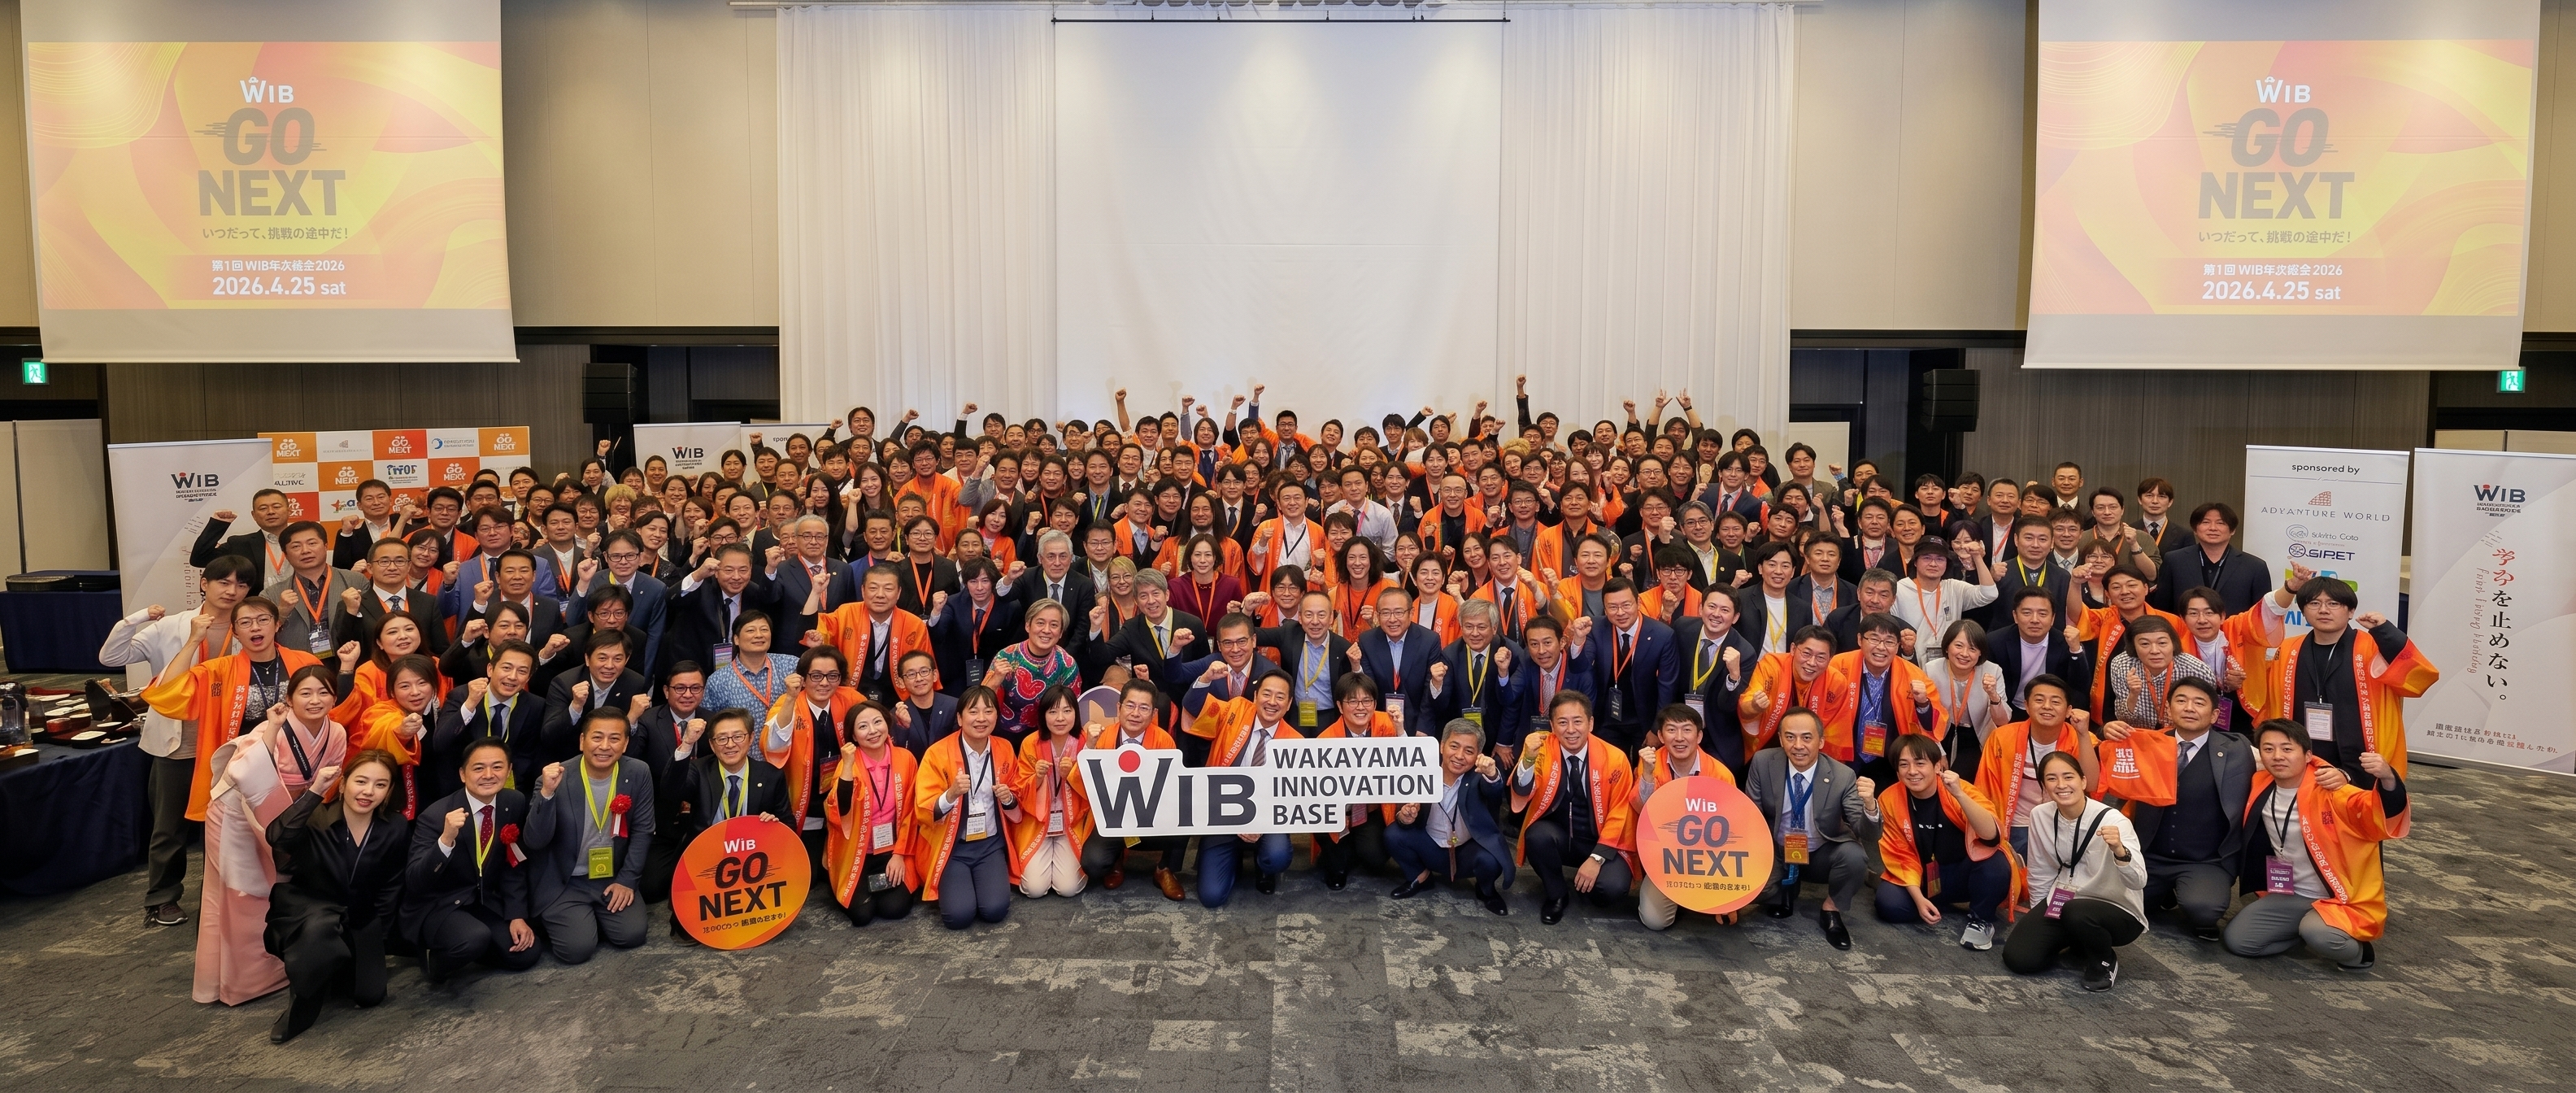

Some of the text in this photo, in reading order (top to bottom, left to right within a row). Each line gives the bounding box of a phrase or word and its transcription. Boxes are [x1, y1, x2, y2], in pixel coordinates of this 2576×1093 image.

[240, 78, 294, 103] WIB
[2256, 78, 2311, 103] WIB
[223, 107, 315, 166] GO
[2230, 107, 2330, 168] GO
[198, 169, 346, 216] NEXT
[2198, 172, 2356, 220] NEXT
[212, 277, 346, 295] 2026.4.25 sat
[2202, 281, 2342, 300] 2026.4.25 sat
[672, 446, 704, 459] WIB
[171, 472, 220, 489] WIB
[2291, 464, 2361, 475] sponsored by
[2473, 485, 2526, 503] WIB
[1273, 747, 1428, 769] WAKAYAMA
[1086, 751, 1258, 830] WIB
[1273, 773, 1435, 798] INNOVATION
[1273, 803, 1339, 826] BASE
[1677, 814, 1730, 848] GO
[715, 851, 768, 889] GO
[1662, 847, 1750, 878] NEXT
[698, 881, 787, 921] NEXT
